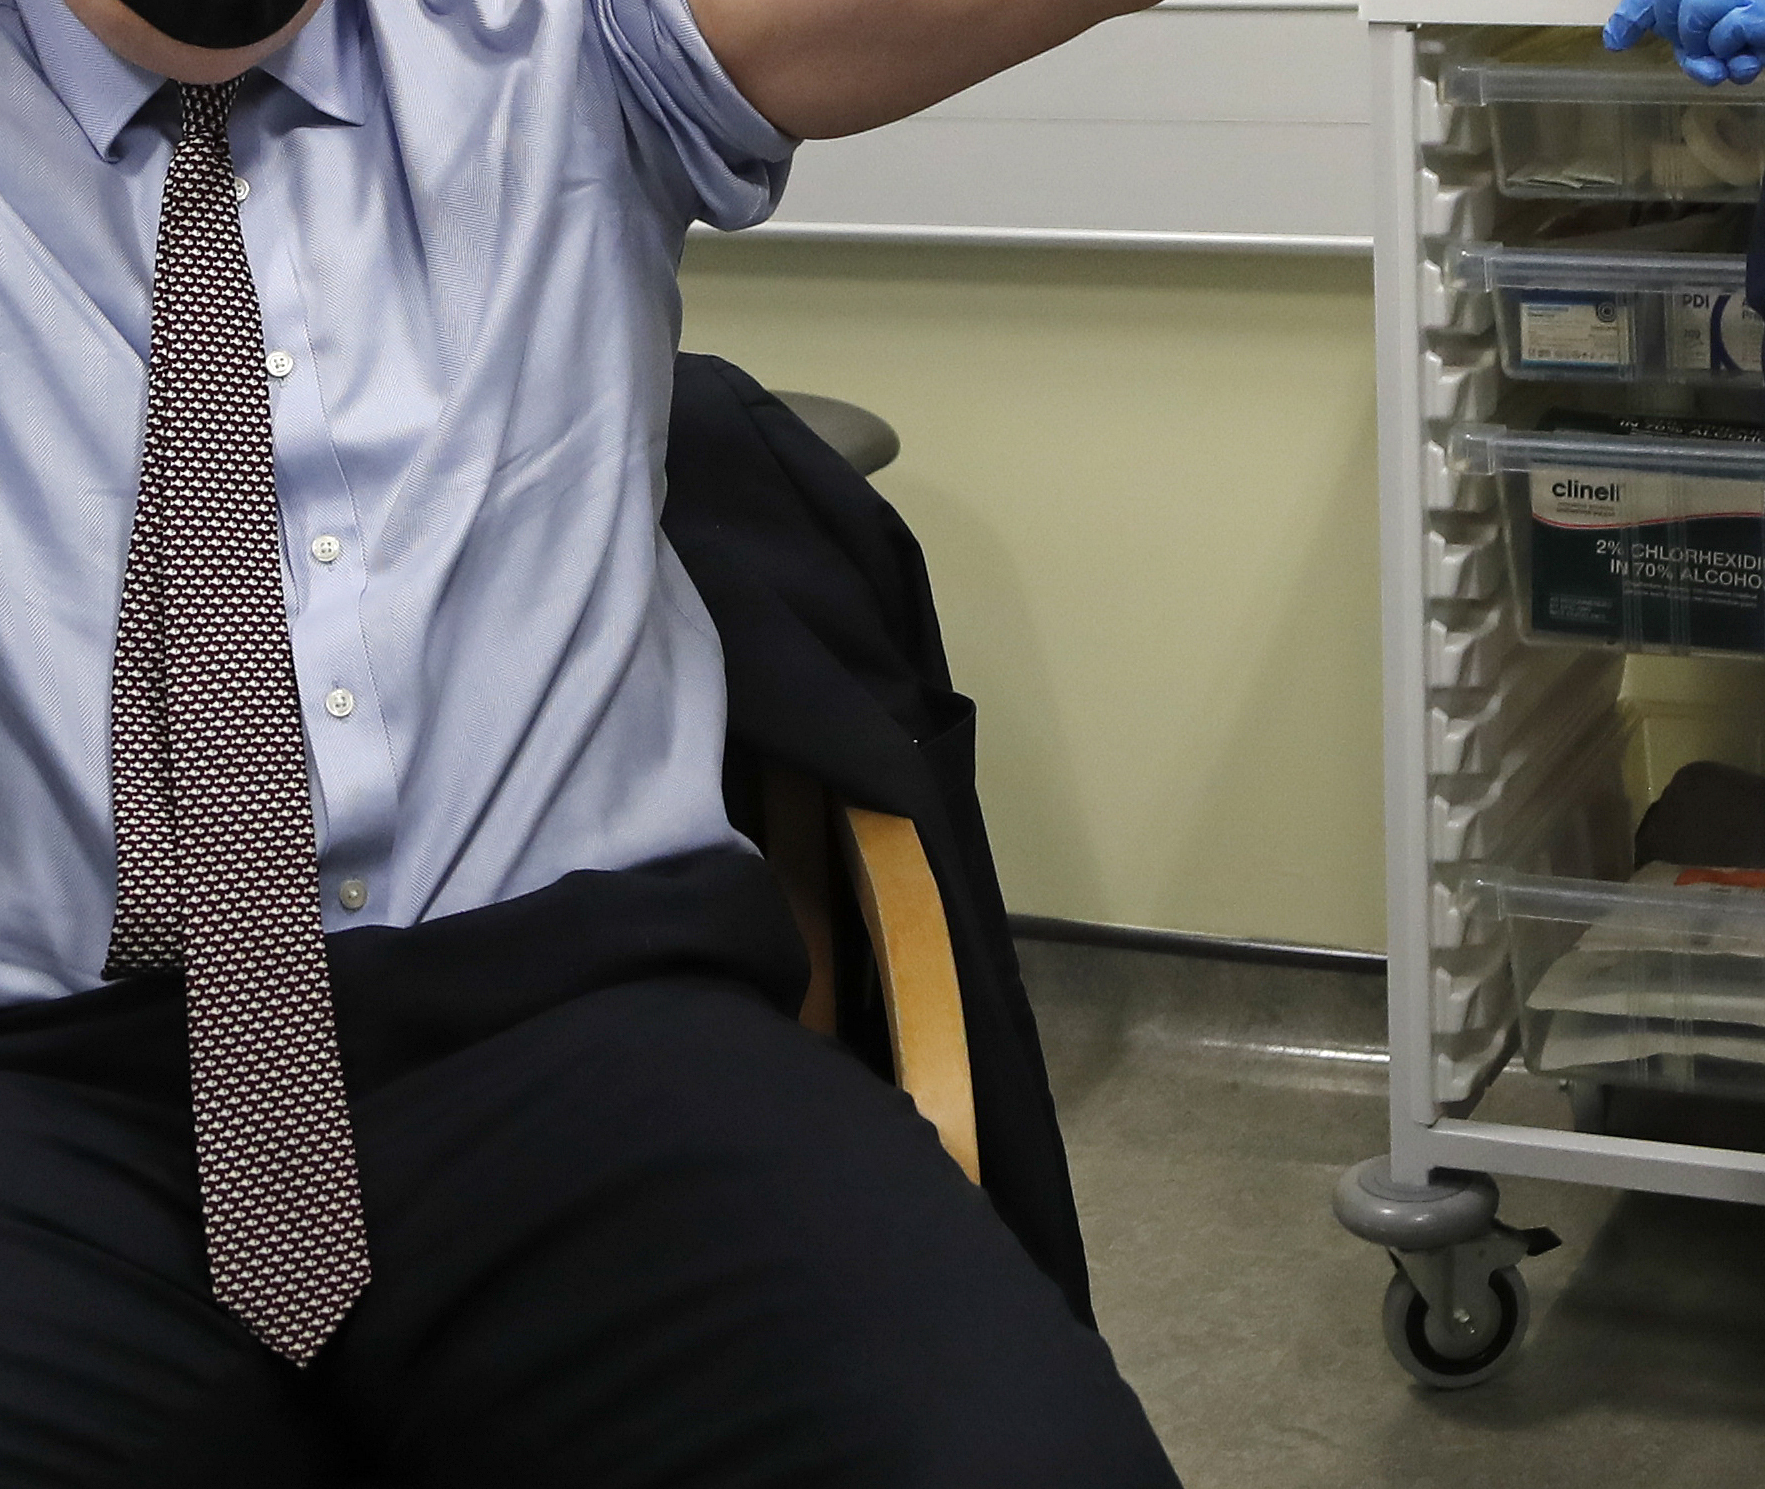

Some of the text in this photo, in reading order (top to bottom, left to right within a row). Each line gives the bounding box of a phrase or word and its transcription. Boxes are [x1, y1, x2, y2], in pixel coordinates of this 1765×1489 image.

[1682, 294, 1710, 309] PDI
[1552, 479, 1620, 502] clinell
[1595, 539, 1622, 555] 2%
[1610, 559, 1629, 576] IN
[1633, 562, 1674, 581] 70%
